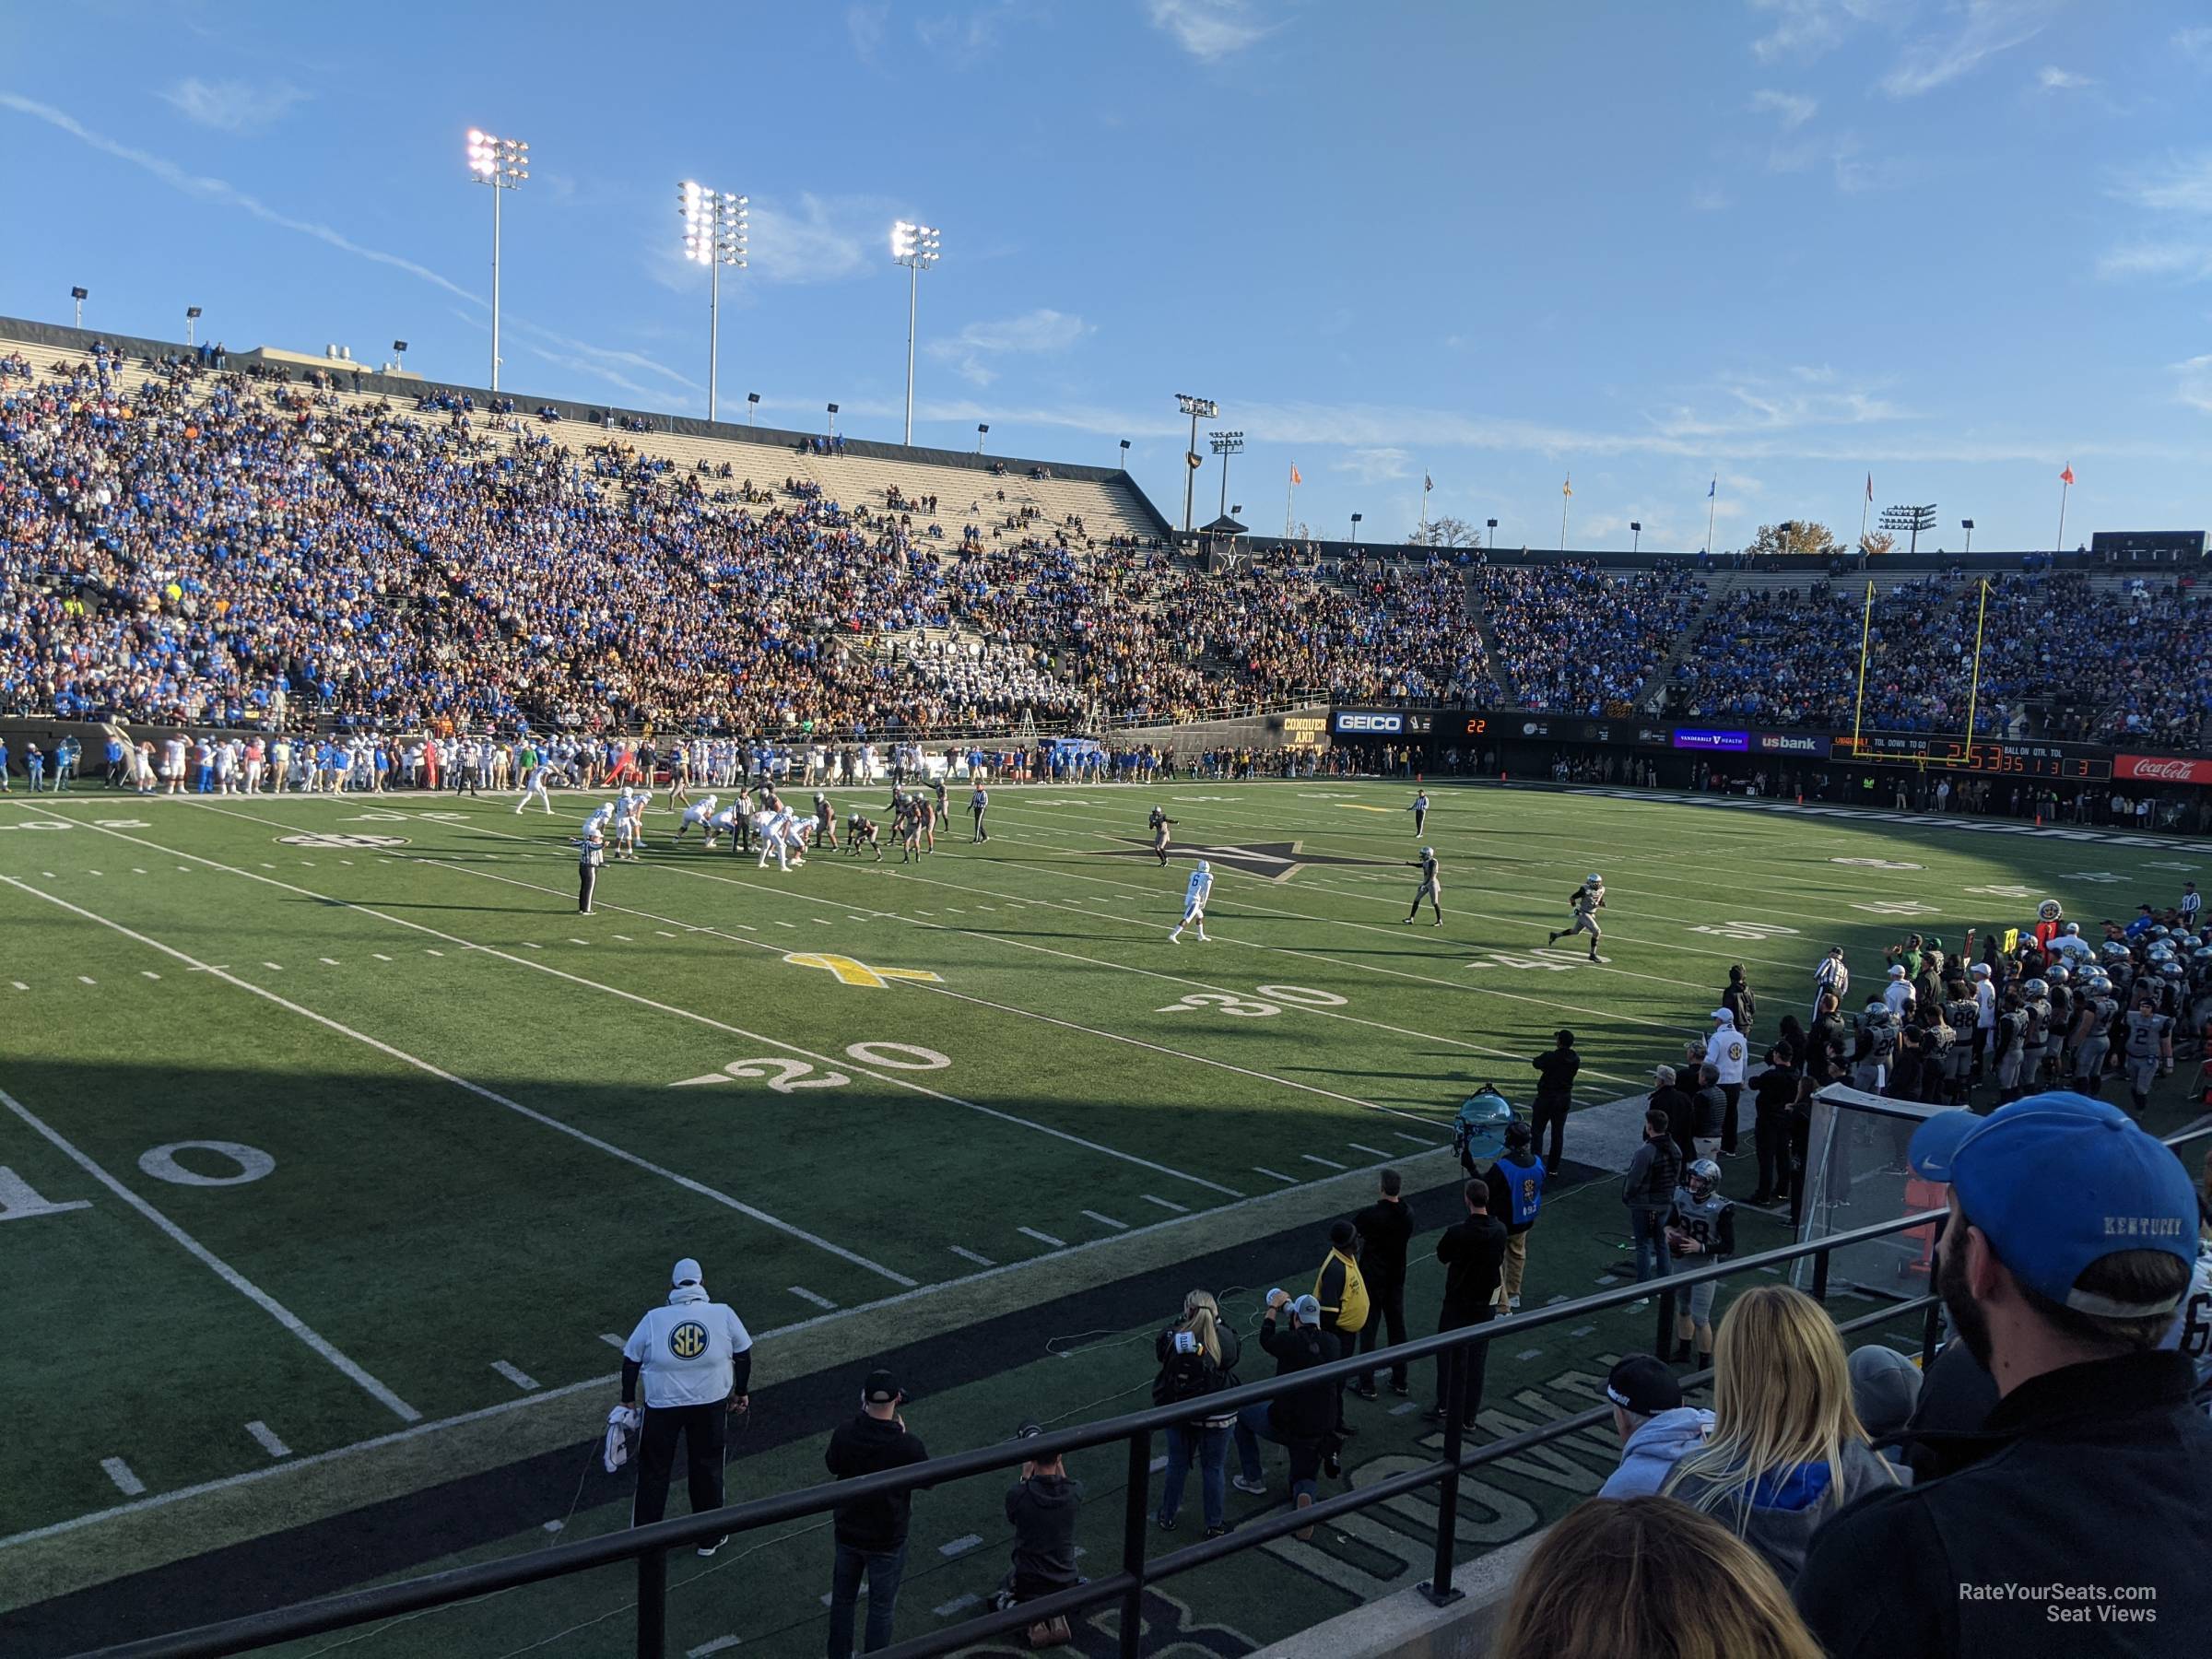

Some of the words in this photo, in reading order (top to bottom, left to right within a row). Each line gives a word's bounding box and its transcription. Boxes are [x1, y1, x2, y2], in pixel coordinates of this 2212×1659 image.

[1284, 718, 1326, 730] CONQUER
[1339, 715, 1401, 730] GEICO
[1467, 719, 1486, 734] 22
[1295, 732, 1314, 743] AND
[1888, 739, 1906, 747] DOWN
[1947, 744, 2001, 771] 2:53
[2020, 747, 2030, 756] ON
[2004, 756, 2023, 772] 35
[2036, 759, 2041, 772] 1
[2051, 761, 2059, 774] 3
[2078, 760, 2088, 775] 3
[1192, 875, 1200, 887] 6
[1694, 922, 1801, 939] 50
[1488, 948, 1611, 971] 40
[1180, 985, 1348, 1017] 30
[1953, 1011, 1974, 1028] 88
[2136, 1028, 2147, 1045] 2
[724, 1041, 951, 1093] 20
[2104, 1217, 2183, 1236] KENTUCKY
[673, 1324, 705, 1356] SEC
